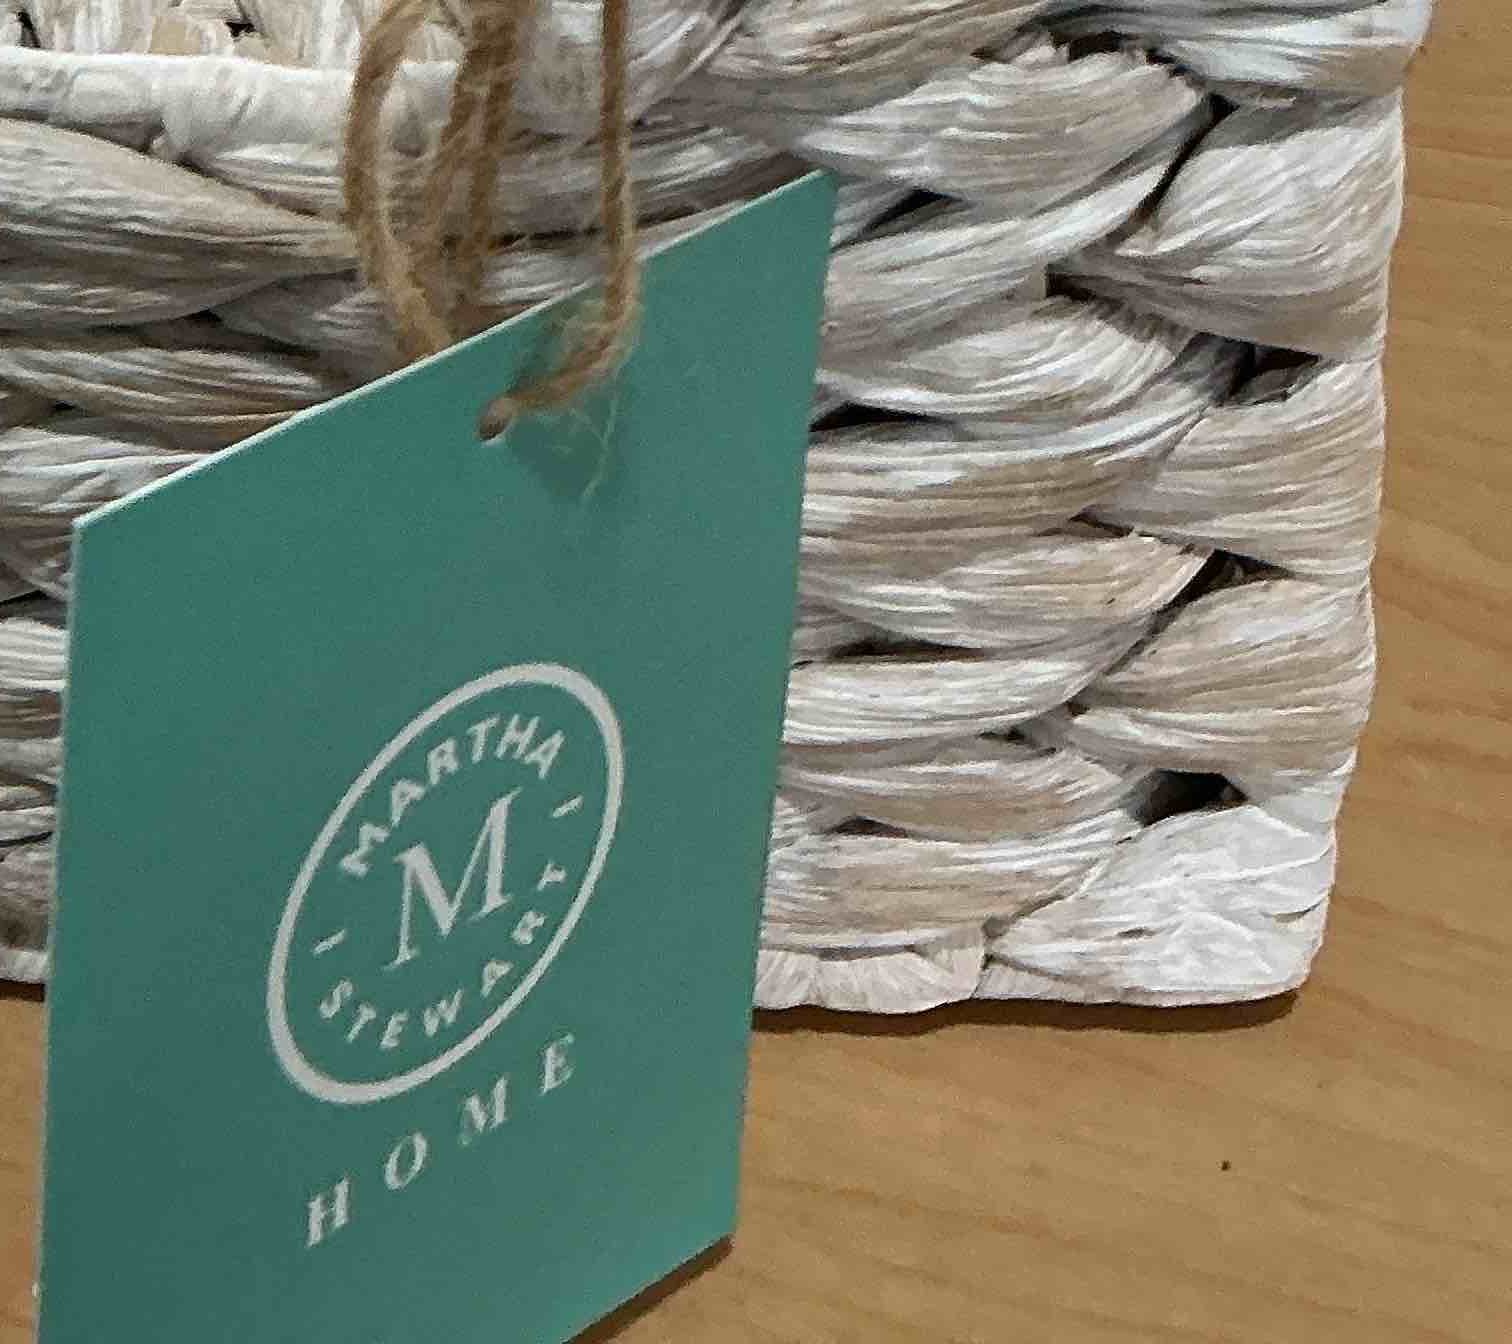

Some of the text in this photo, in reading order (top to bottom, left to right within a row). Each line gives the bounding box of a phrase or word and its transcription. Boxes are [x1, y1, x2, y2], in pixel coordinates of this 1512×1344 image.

[341, 714, 565, 878] MARTHA
[383, 786, 522, 970] M
[319, 860, 568, 1050] STEWART
[306, 1032, 575, 1248] HOME
